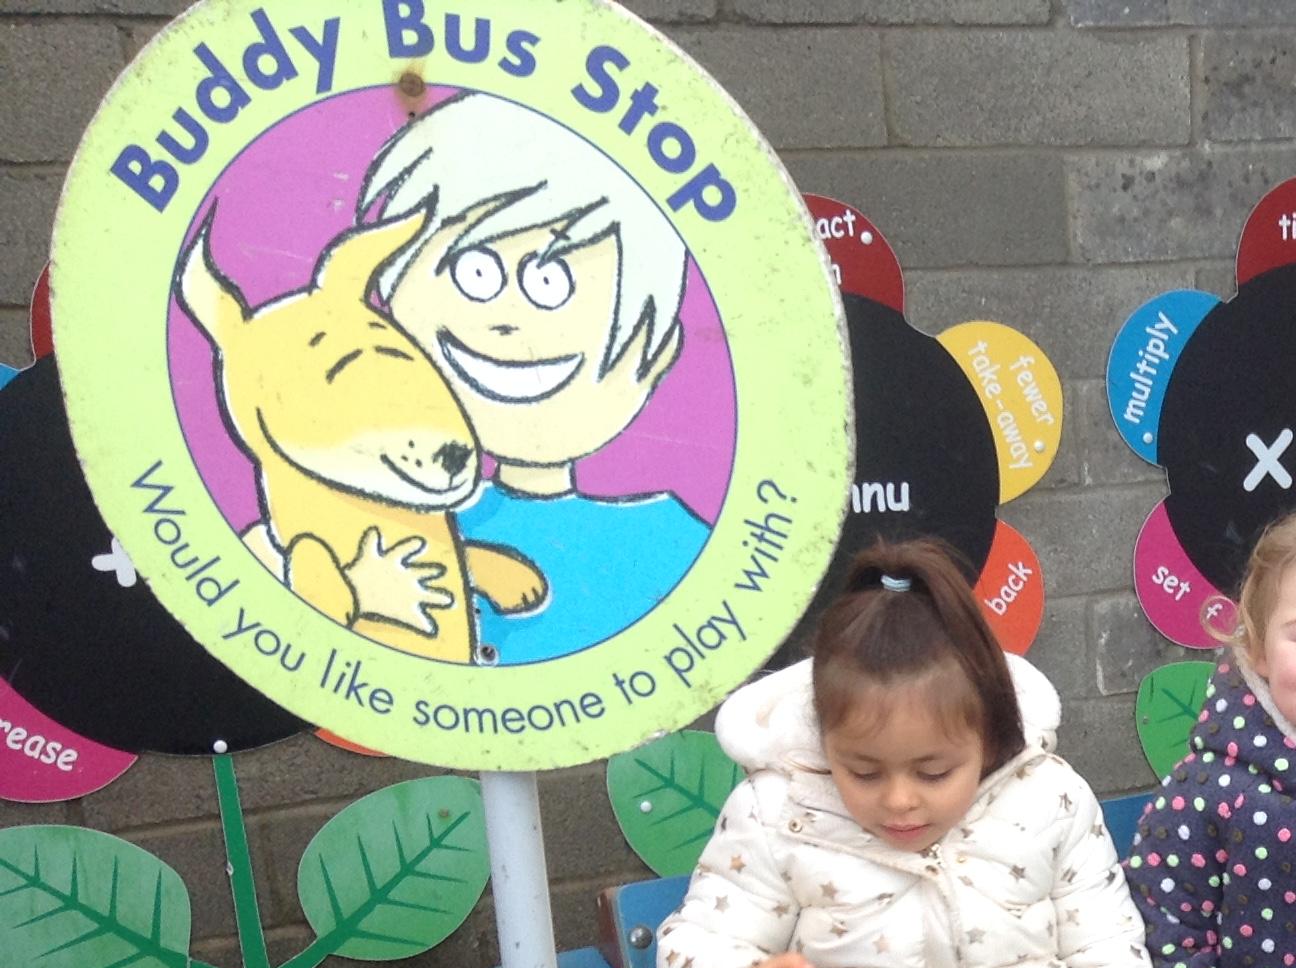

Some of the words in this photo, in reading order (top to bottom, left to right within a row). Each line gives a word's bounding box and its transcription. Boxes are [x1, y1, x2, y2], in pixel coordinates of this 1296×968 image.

[110, 7, 341, 213] Buddy
[381, 0, 541, 78] Bus
[570, 45, 737, 222] Stop
[815, 209, 857, 239] act
[967, 340, 1033, 469] take-away
[1008, 354, 1054, 425] fewer
[1123, 310, 1179, 424] multiply
[130, 460, 240, 607] Would
[222, 607, 306, 672] you
[319, 648, 394, 714] like
[412, 691, 606, 735] someone
[612, 671, 656, 705] to
[664, 600, 747, 688] play
[734, 479, 798, 593] with?
[983, 561, 1033, 616] back
[1151, 565, 1191, 601] set
